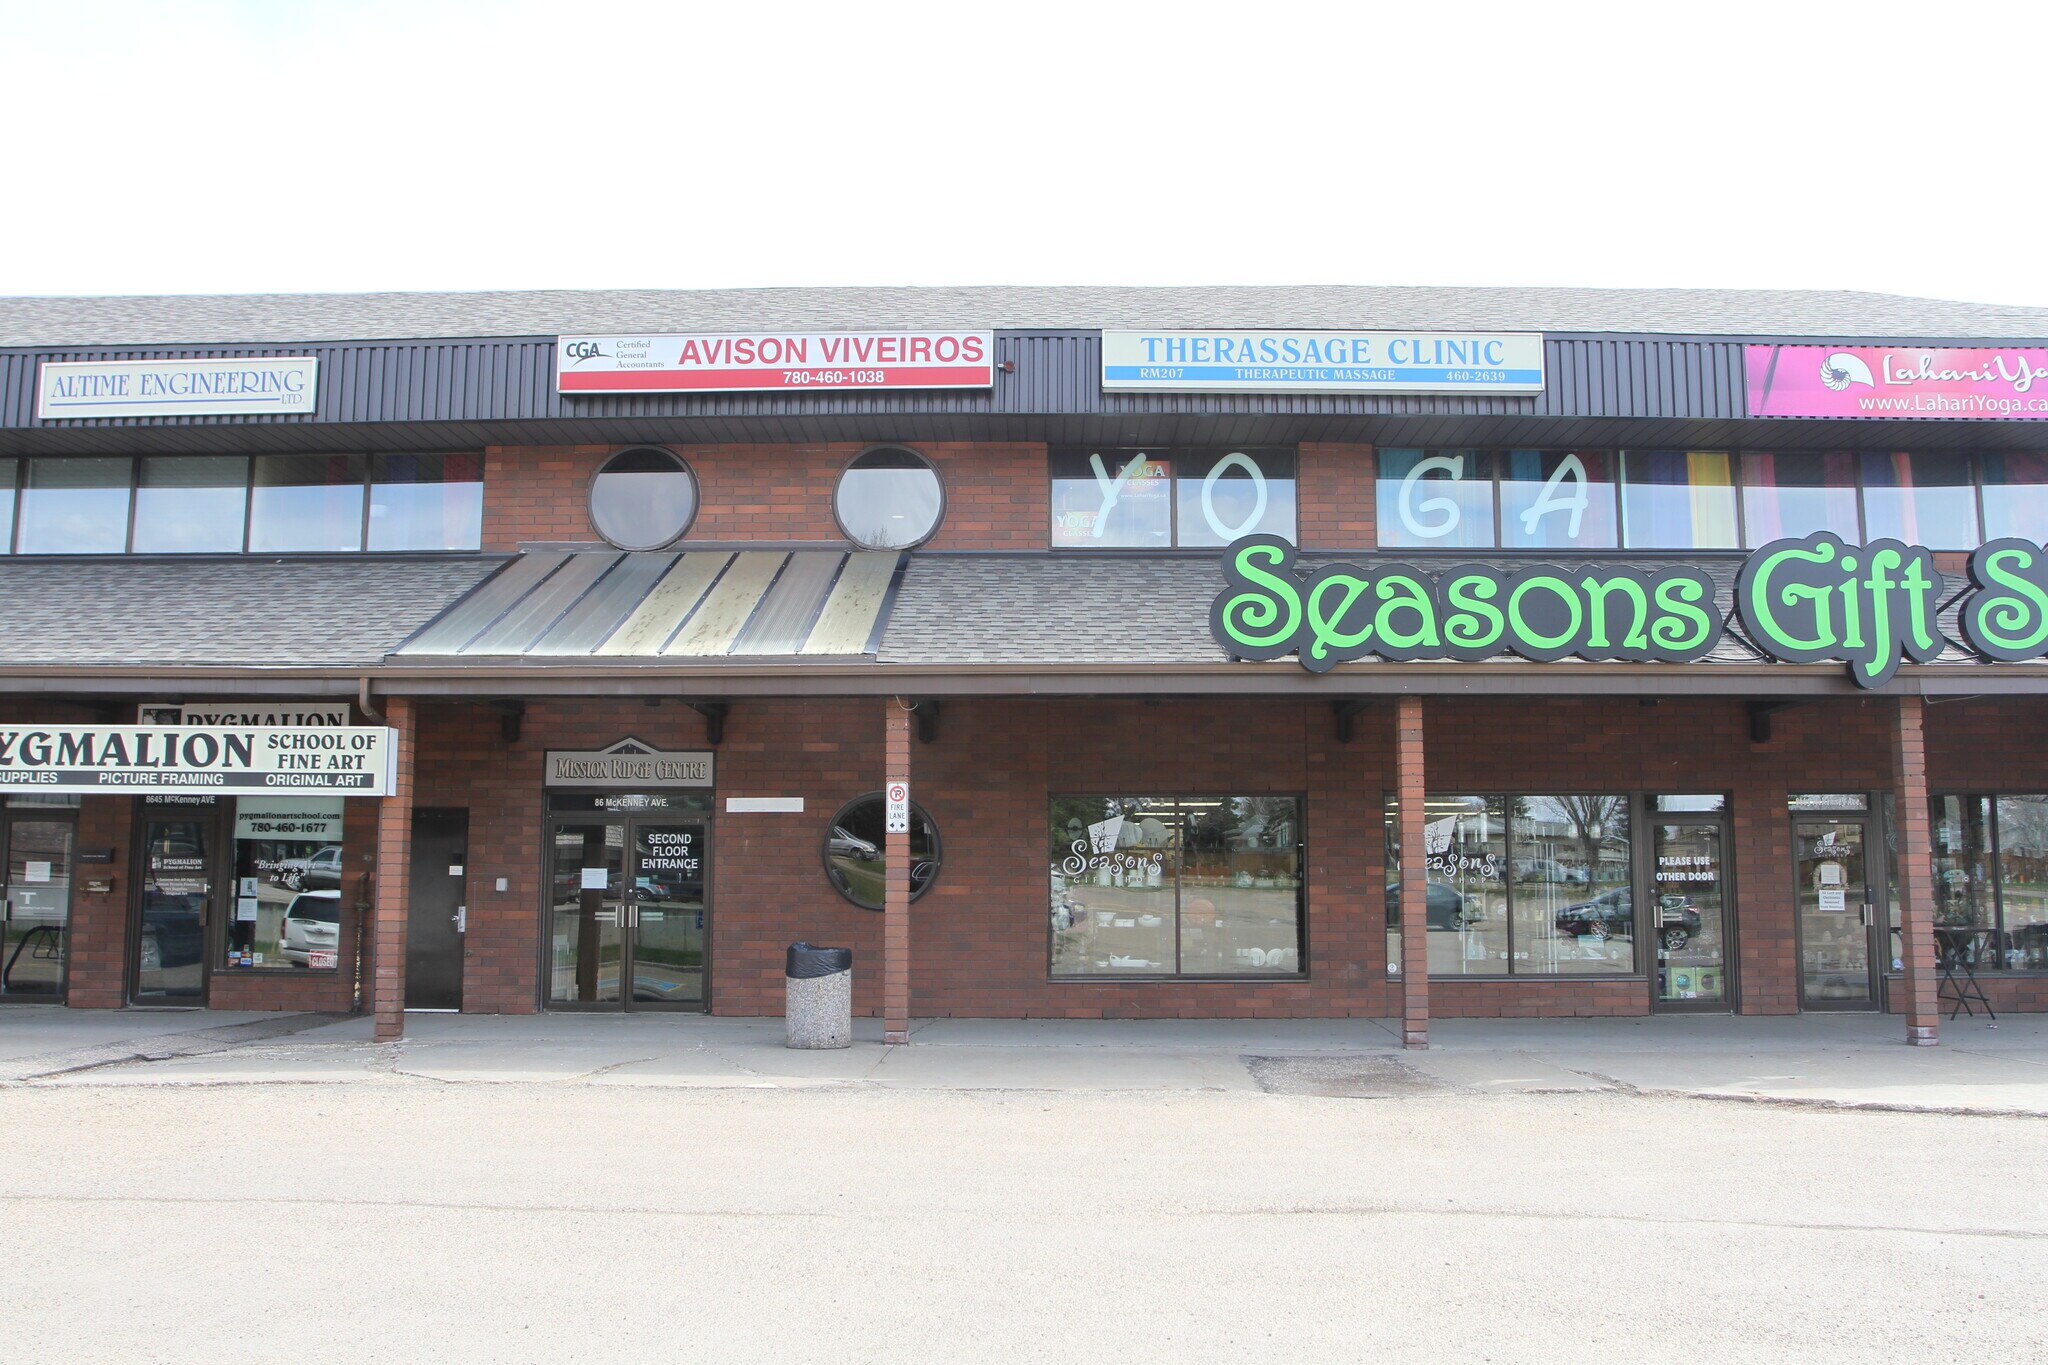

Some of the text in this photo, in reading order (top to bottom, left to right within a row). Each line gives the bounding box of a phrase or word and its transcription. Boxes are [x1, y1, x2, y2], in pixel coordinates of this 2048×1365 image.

[566, 341, 600, 358] CGA
[616, 340, 651, 349] Certified
[616, 351, 647, 359] General
[678, 336, 984, 365] AVISON VIVEIROS
[1140, 337, 1504, 365] THERASSAGE CLINIC
[616, 360, 665, 368] Accountants
[783, 371, 885, 384] 780-460-1038
[1140, 368, 1184, 378] RM207
[1235, 368, 1396, 380] THERAPEUTIC MASSAGE
[1446, 371, 1506, 382] 460-2639
[51, 370, 305, 398] ALTIME ENGINEERING
[281, 394, 305, 405] LTD.
[1859, 394, 2048, 416] www.LahariYoga.ca
[1222, 544, 1711, 660] Seasons
[1752, 542, 1934, 677] Gift
[267, 734, 377, 750] SCHOOL OF
[277, 753, 366, 770] FINE ART
[0, 772, 58, 783] UPPLIES
[99, 773, 224, 785] PICTURE FRAMING
[265, 774, 363, 786] ORIGINAL ART
[200, 795, 216, 804] AVE
[594, 798, 603, 807] 86
[650, 798, 669, 807] AVE.
[890, 803, 905, 811] FIRE
[239, 811, 340, 821] pygmalionartschool.com
[890, 812, 905, 820] LANE
[250, 822, 327, 833] 780-460-1677
[648, 833, 692, 844] SECOND
[652, 846, 689, 857] FLOOR
[1063, 839, 1163, 876] Seasons
[1658, 856, 1710, 866] PLEASE USE
[641, 858, 699, 869] ENTRANCE
[1397, 853, 1495, 877] easons
[270, 874, 280, 882] to
[1656, 871, 1715, 881] OTHER DOOR
[312, 957, 334, 967] CLOSED
